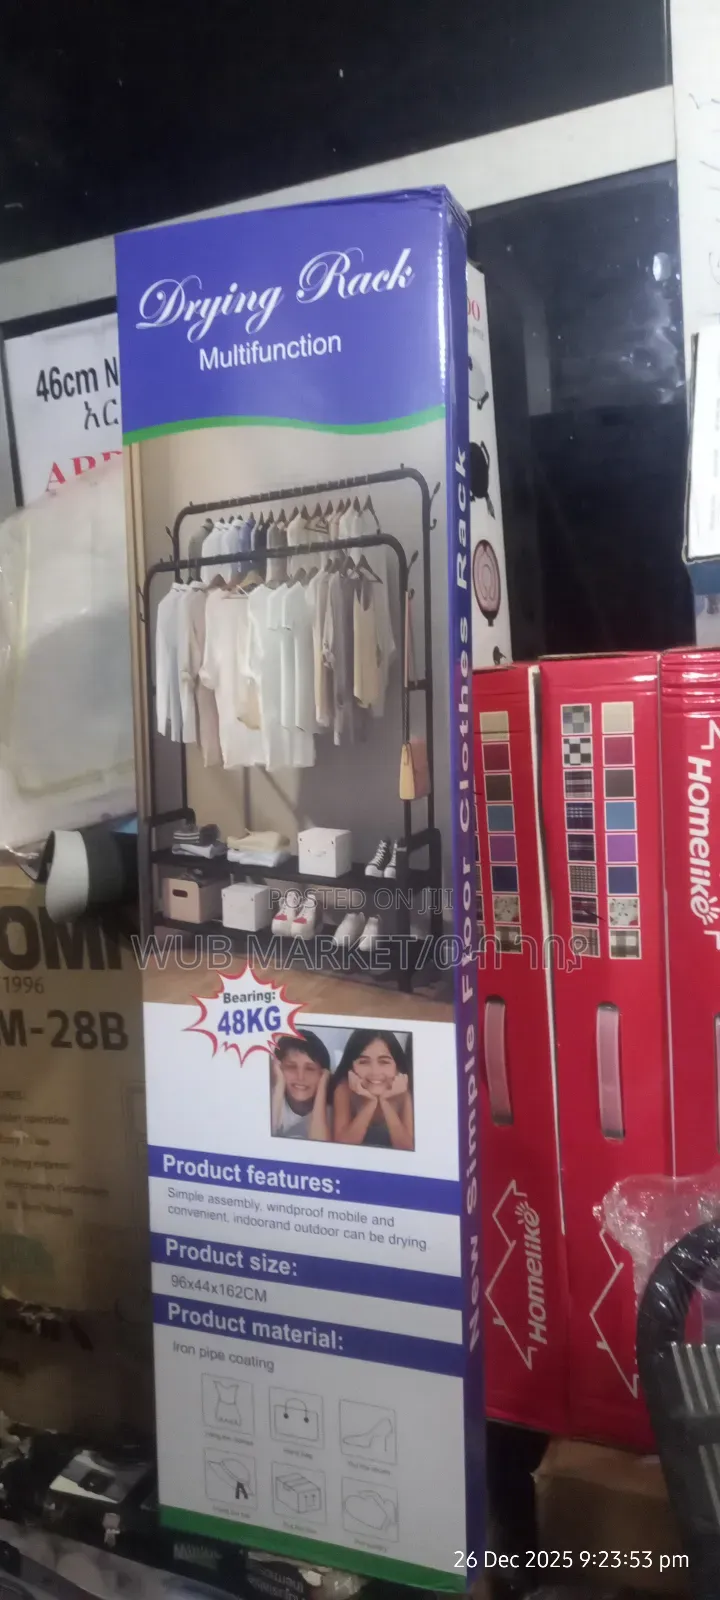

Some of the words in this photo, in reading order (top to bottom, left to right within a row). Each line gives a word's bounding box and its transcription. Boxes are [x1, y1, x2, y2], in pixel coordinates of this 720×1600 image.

[136, 275, 283, 343] Drying
[296, 247, 416, 304] Rack
[199, 332, 342, 372] Multifunction
[36, 366, 99, 402] 46cm
[454, 446, 468, 590] Rack
[458, 616, 470, 833] Clothes
[687, 755, 713, 925] Homelike
[461, 856, 474, 1003] Floor
[2, 976, 44, 995] 1996
[222, 990, 276, 1004] Bearing:
[0, 1008, 129, 1051] M-28B
[217, 1005, 282, 1036] 48KG
[464, 1024, 478, 1215] Simple
[162, 1153, 241, 1183] Product
[246, 1164, 341, 1195] features:
[167, 1187, 205, 1203] Simple
[266, 1201, 324, 1218] windproof
[327, 1209, 368, 1224] mobile
[371, 1216, 395, 1228] and
[233, 1212, 291, 1232] indoorand
[293, 1221, 340, 1237] outdoor
[343, 1228, 366, 1241] can
[369, 1230, 385, 1243] be
[165, 1237, 244, 1268] Product
[249, 1254, 298, 1277] size:
[517, 1205, 548, 1345] Homelike
[170, 1274, 268, 1303] 96x44x162CM
[469, 1234, 480, 1353] New
[167, 1301, 246, 1334] Product
[251, 1317, 344, 1351] material:
[172, 1340, 196, 1356] Iron
[199, 1346, 226, 1362] pipe
[228, 1353, 275, 1374] coating
